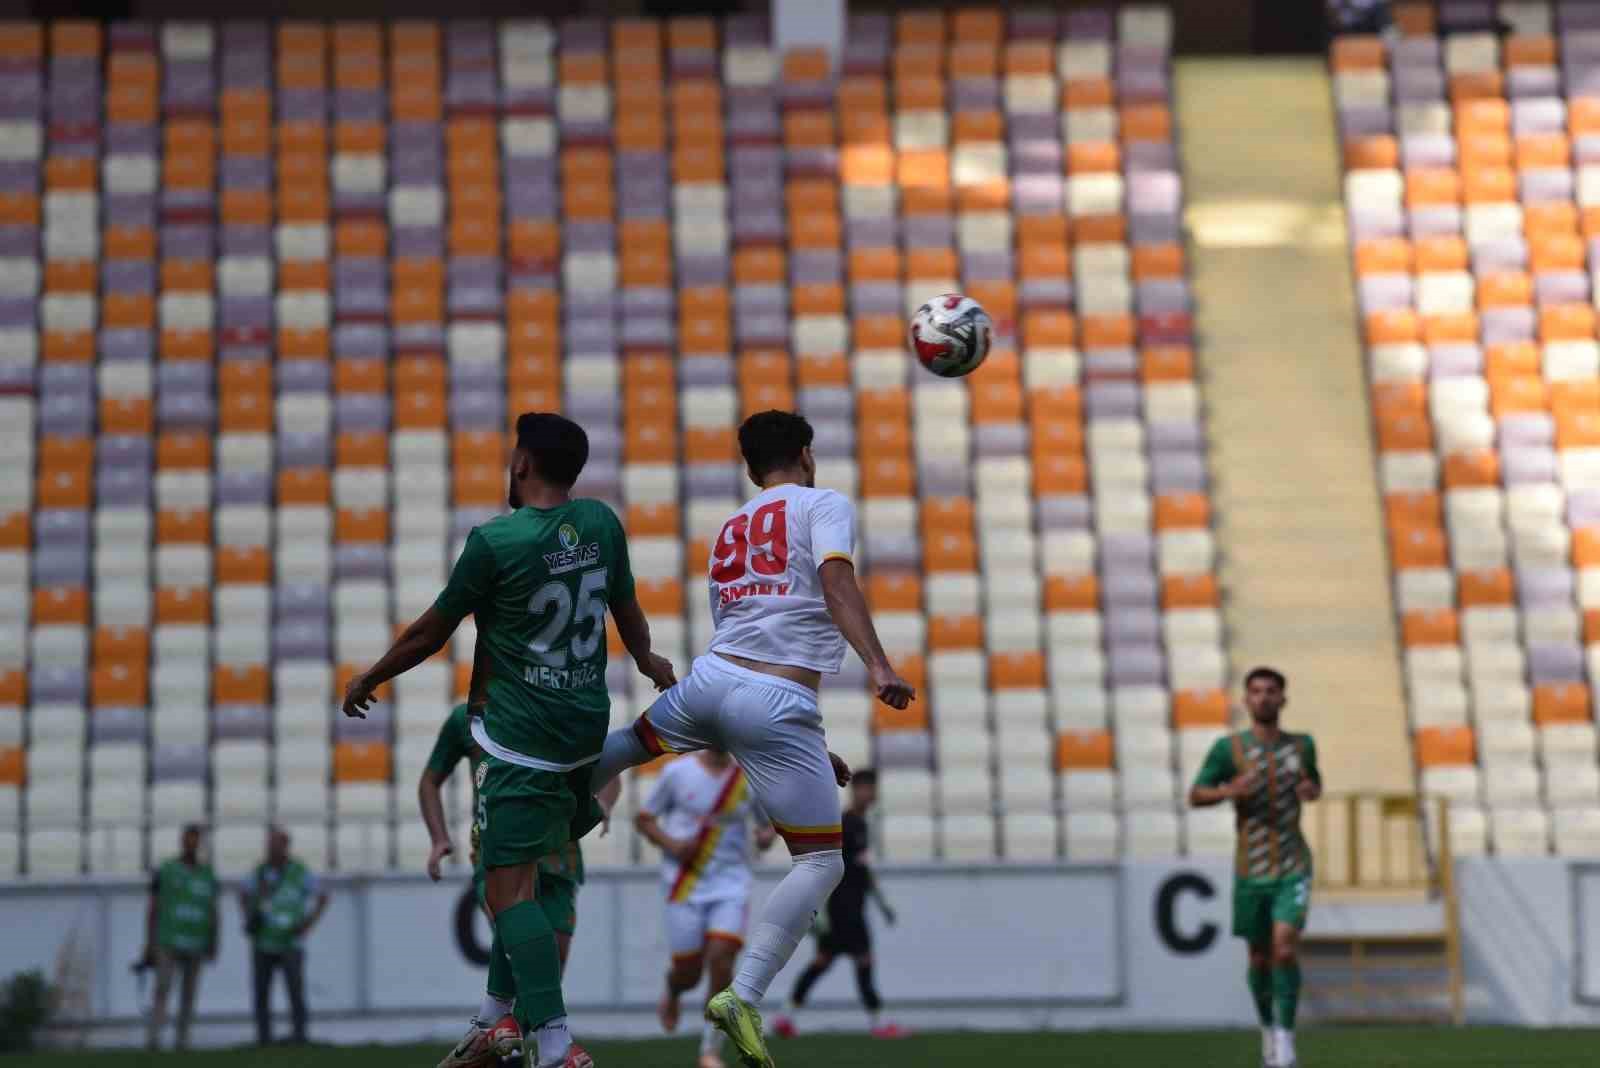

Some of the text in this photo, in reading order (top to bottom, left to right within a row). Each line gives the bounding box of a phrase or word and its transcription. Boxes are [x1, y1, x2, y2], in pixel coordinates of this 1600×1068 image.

[711, 499, 788, 584] 99
[528, 566, 608, 668] 25
[1157, 872, 1219, 954] C
